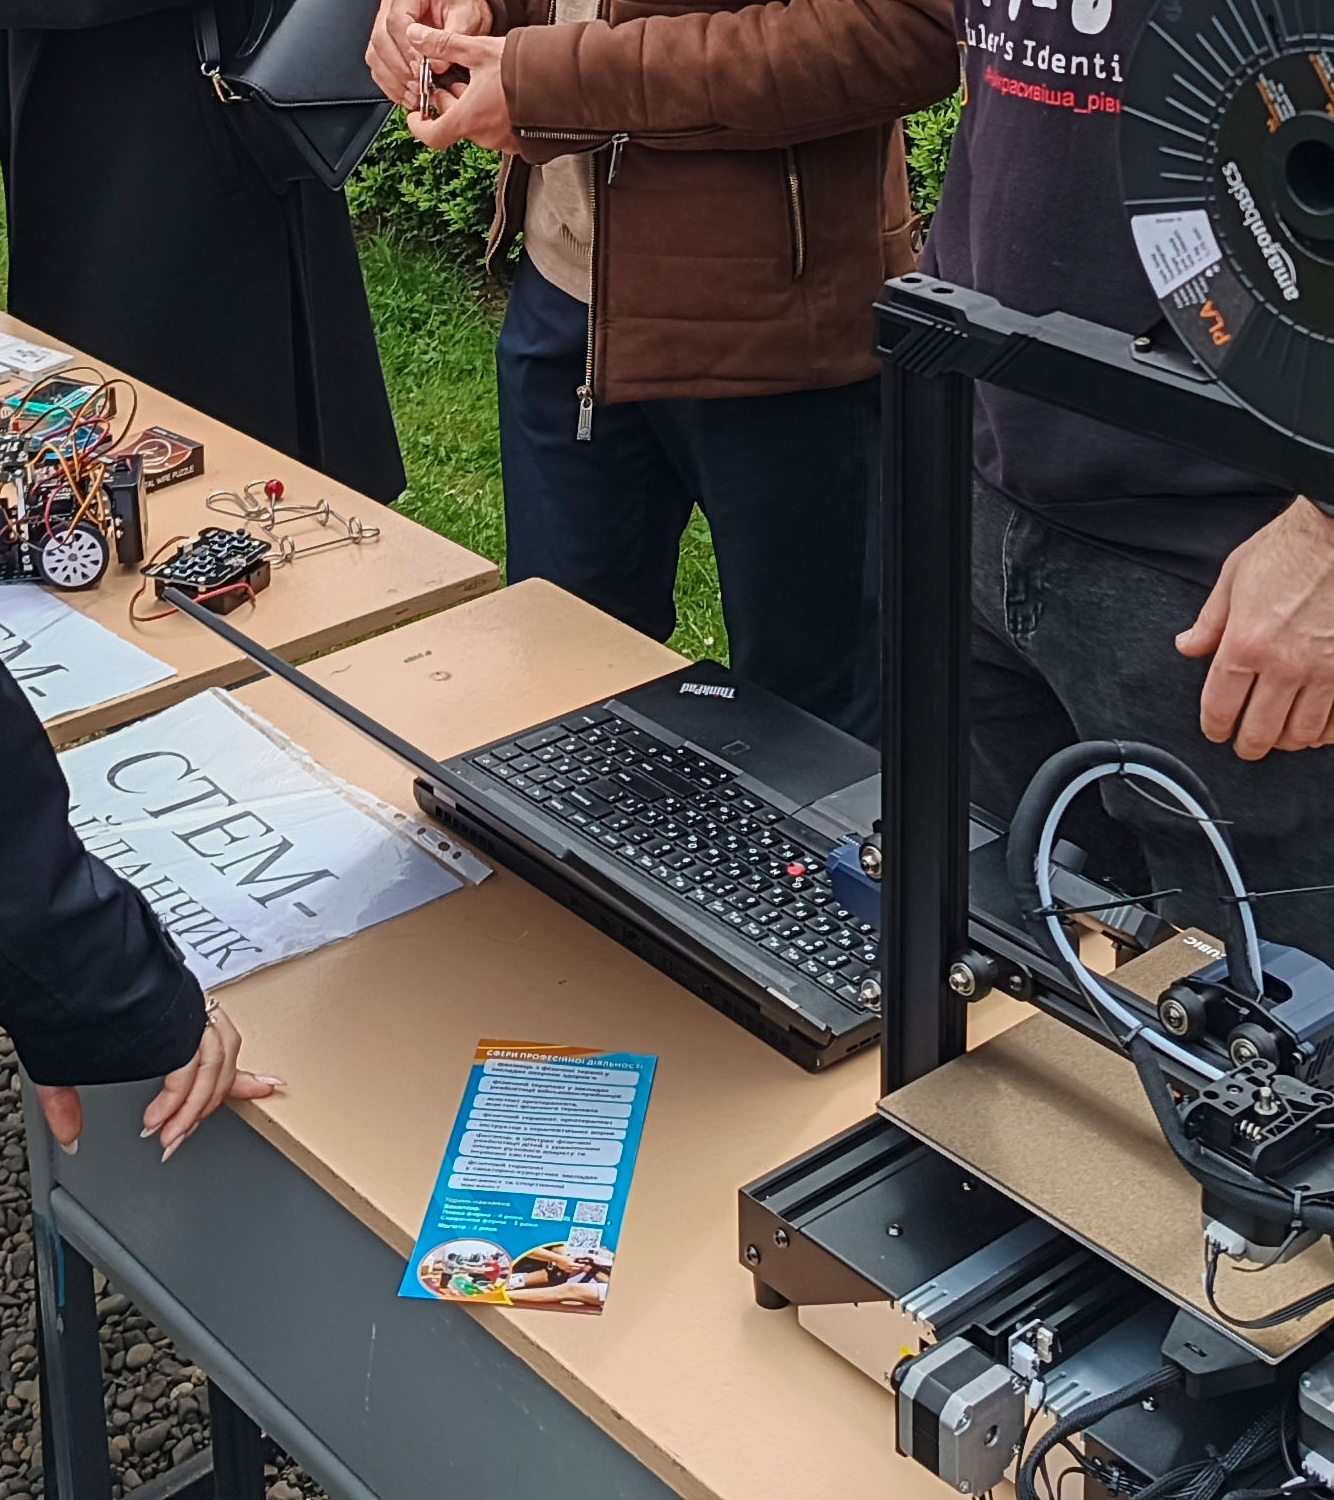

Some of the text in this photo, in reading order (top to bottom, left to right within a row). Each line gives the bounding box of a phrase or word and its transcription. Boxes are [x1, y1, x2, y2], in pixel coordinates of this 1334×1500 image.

[1021, 38, 1124, 84] Identi
[1221, 160, 1300, 301] amazonbasics
[1199, 299, 1233, 347] PLA
[679, 682, 736, 699] ThinkPad
[105, 749, 341, 919] СТЕМ-
